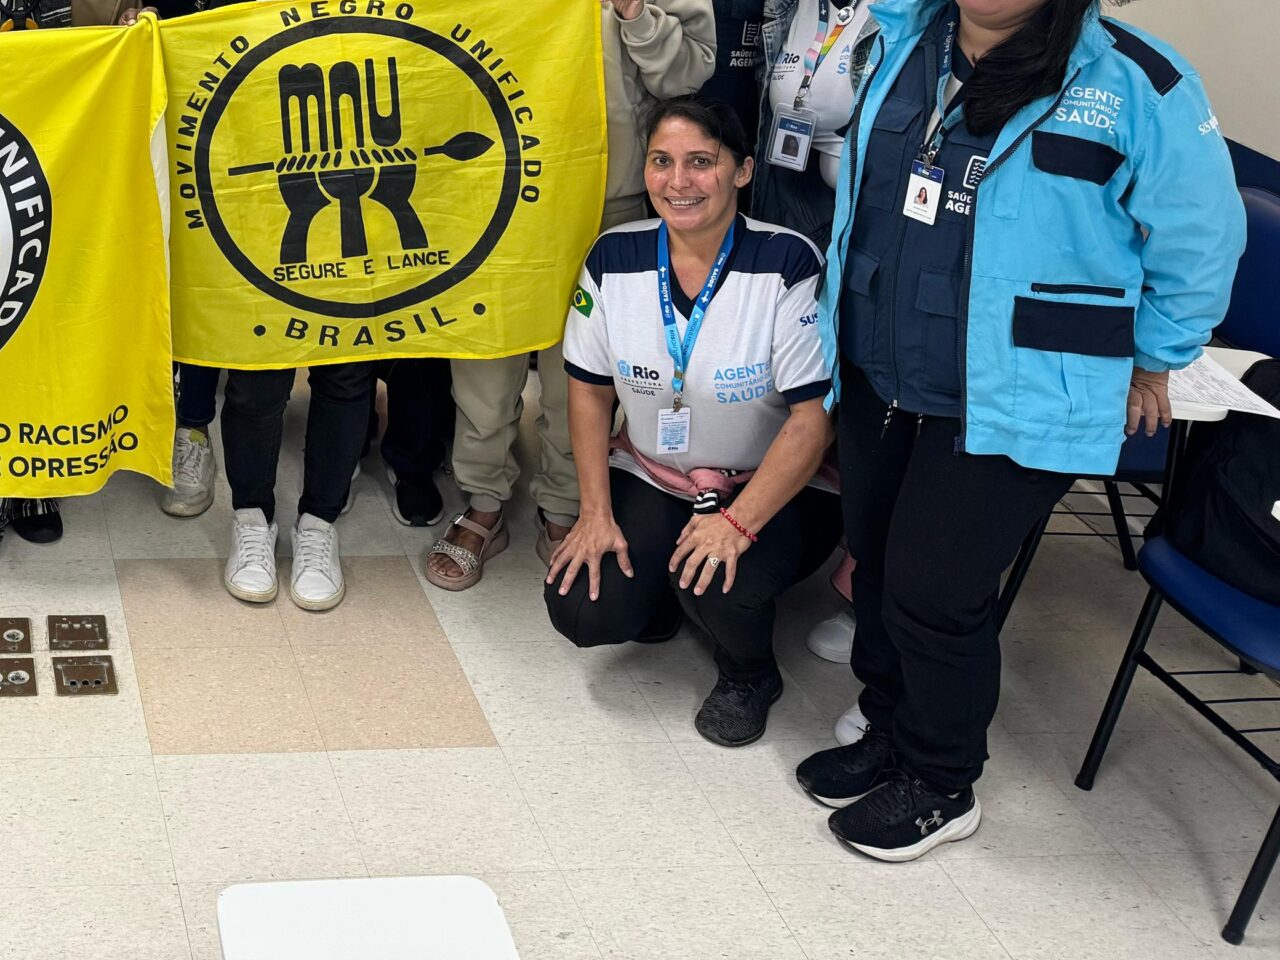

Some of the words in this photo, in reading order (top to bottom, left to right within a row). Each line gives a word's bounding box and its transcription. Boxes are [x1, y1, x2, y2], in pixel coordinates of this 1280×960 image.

[176, 35, 251, 230] MOVIMENTO
[280, 0, 415, 27] NEGRO
[451, 23, 543, 204] UNIFICADO
[1055, 107, 1116, 134] SAÚDE
[947, 190, 973, 203] SAÚD
[945, 202, 971, 216] AGE
[273, 262, 348, 283] SEGURE
[364, 259, 375, 275] E
[388, 250, 451, 270] LANCE
[707, 268, 719, 288] SAÚDE
[285, 306, 457, 347] BRASIL
[633, 365, 660, 381] Rio
[713, 360, 772, 381] AGENTE
[631, 386, 656, 397] SAÚDE
[715, 376, 764, 390] COMUNITÁRIO
[716, 381, 773, 404] SAÚDE
[19, 404, 129, 446] RACISMO
[8, 432, 139, 479] OPRESSÃO
